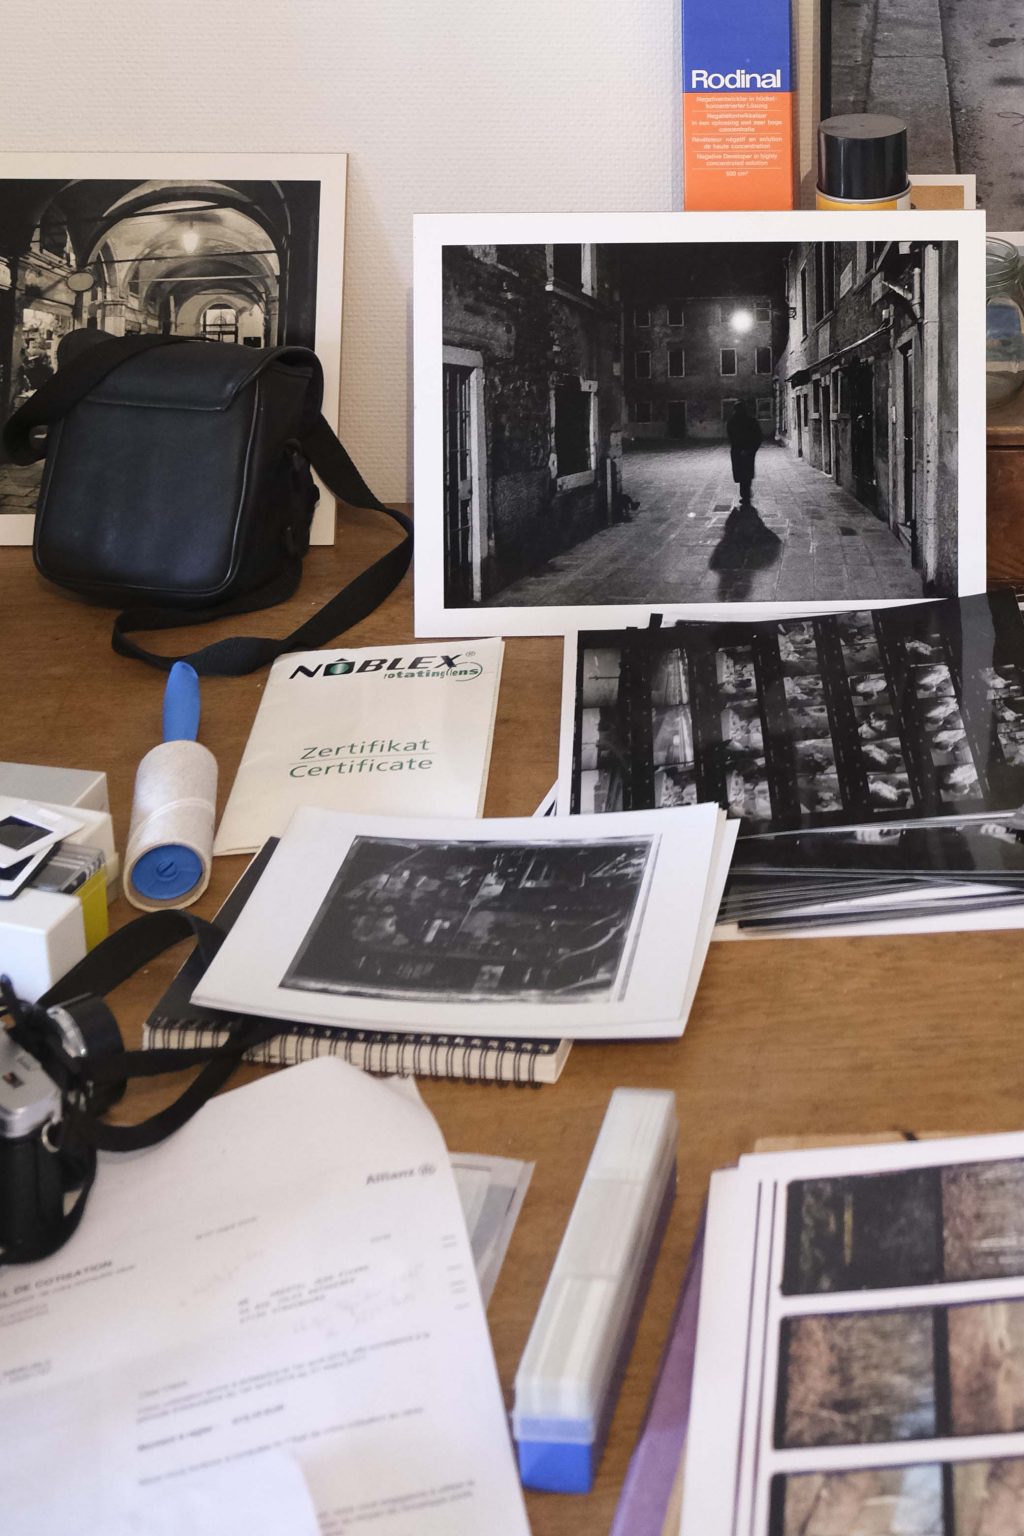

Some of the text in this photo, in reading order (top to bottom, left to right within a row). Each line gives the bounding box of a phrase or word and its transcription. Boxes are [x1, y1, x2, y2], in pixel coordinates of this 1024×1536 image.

[691, 69, 781, 89] Rodinal
[300, 739, 432, 760] Zertifikat
[289, 757, 433, 778] Certificate
